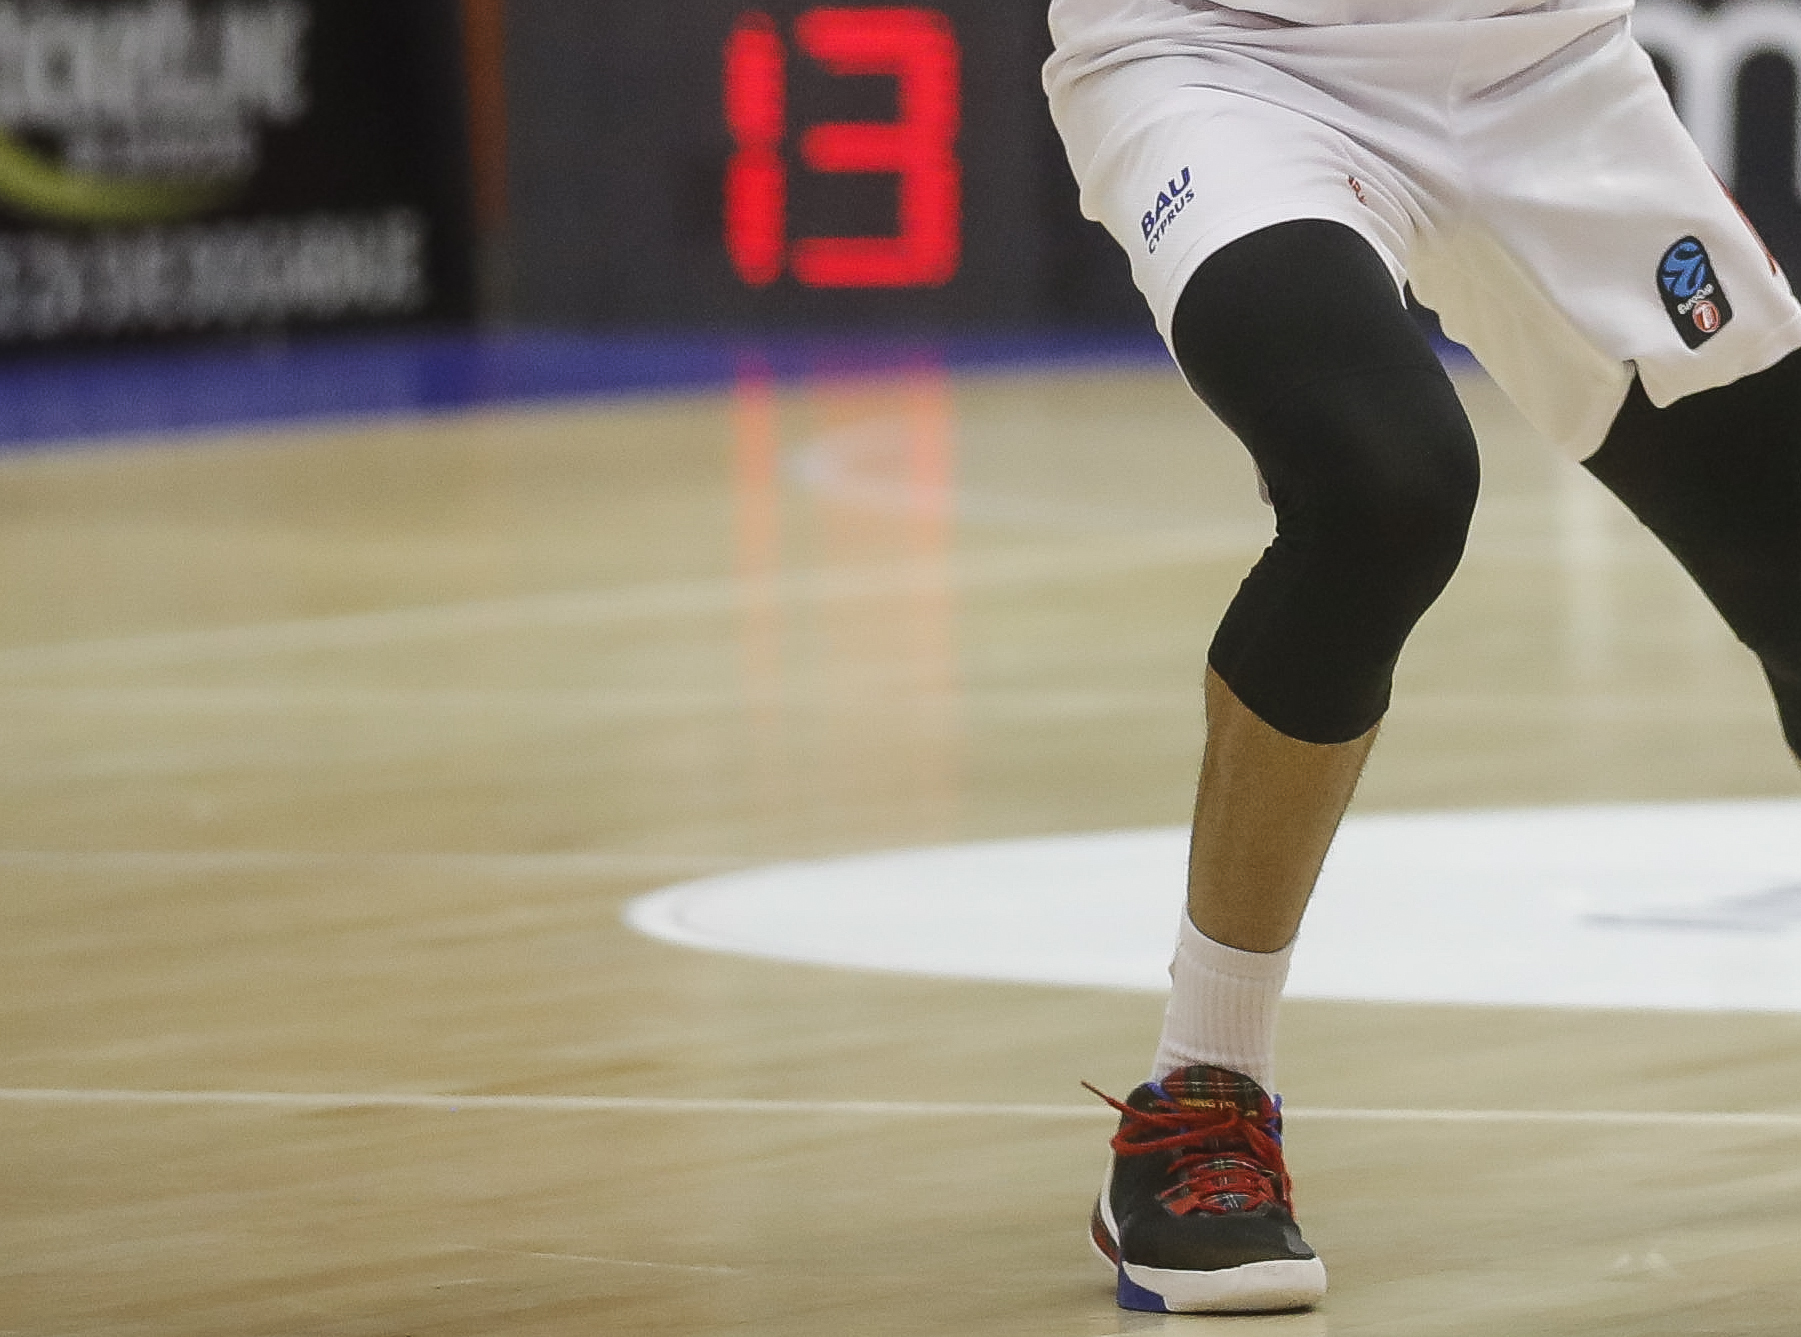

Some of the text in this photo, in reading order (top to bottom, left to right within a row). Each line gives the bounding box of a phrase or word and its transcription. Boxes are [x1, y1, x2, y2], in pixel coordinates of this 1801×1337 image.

[722, 6, 961, 288] 13
[1141, 166, 1191, 241] BAU
[1148, 188, 1196, 255] CYPRUS
